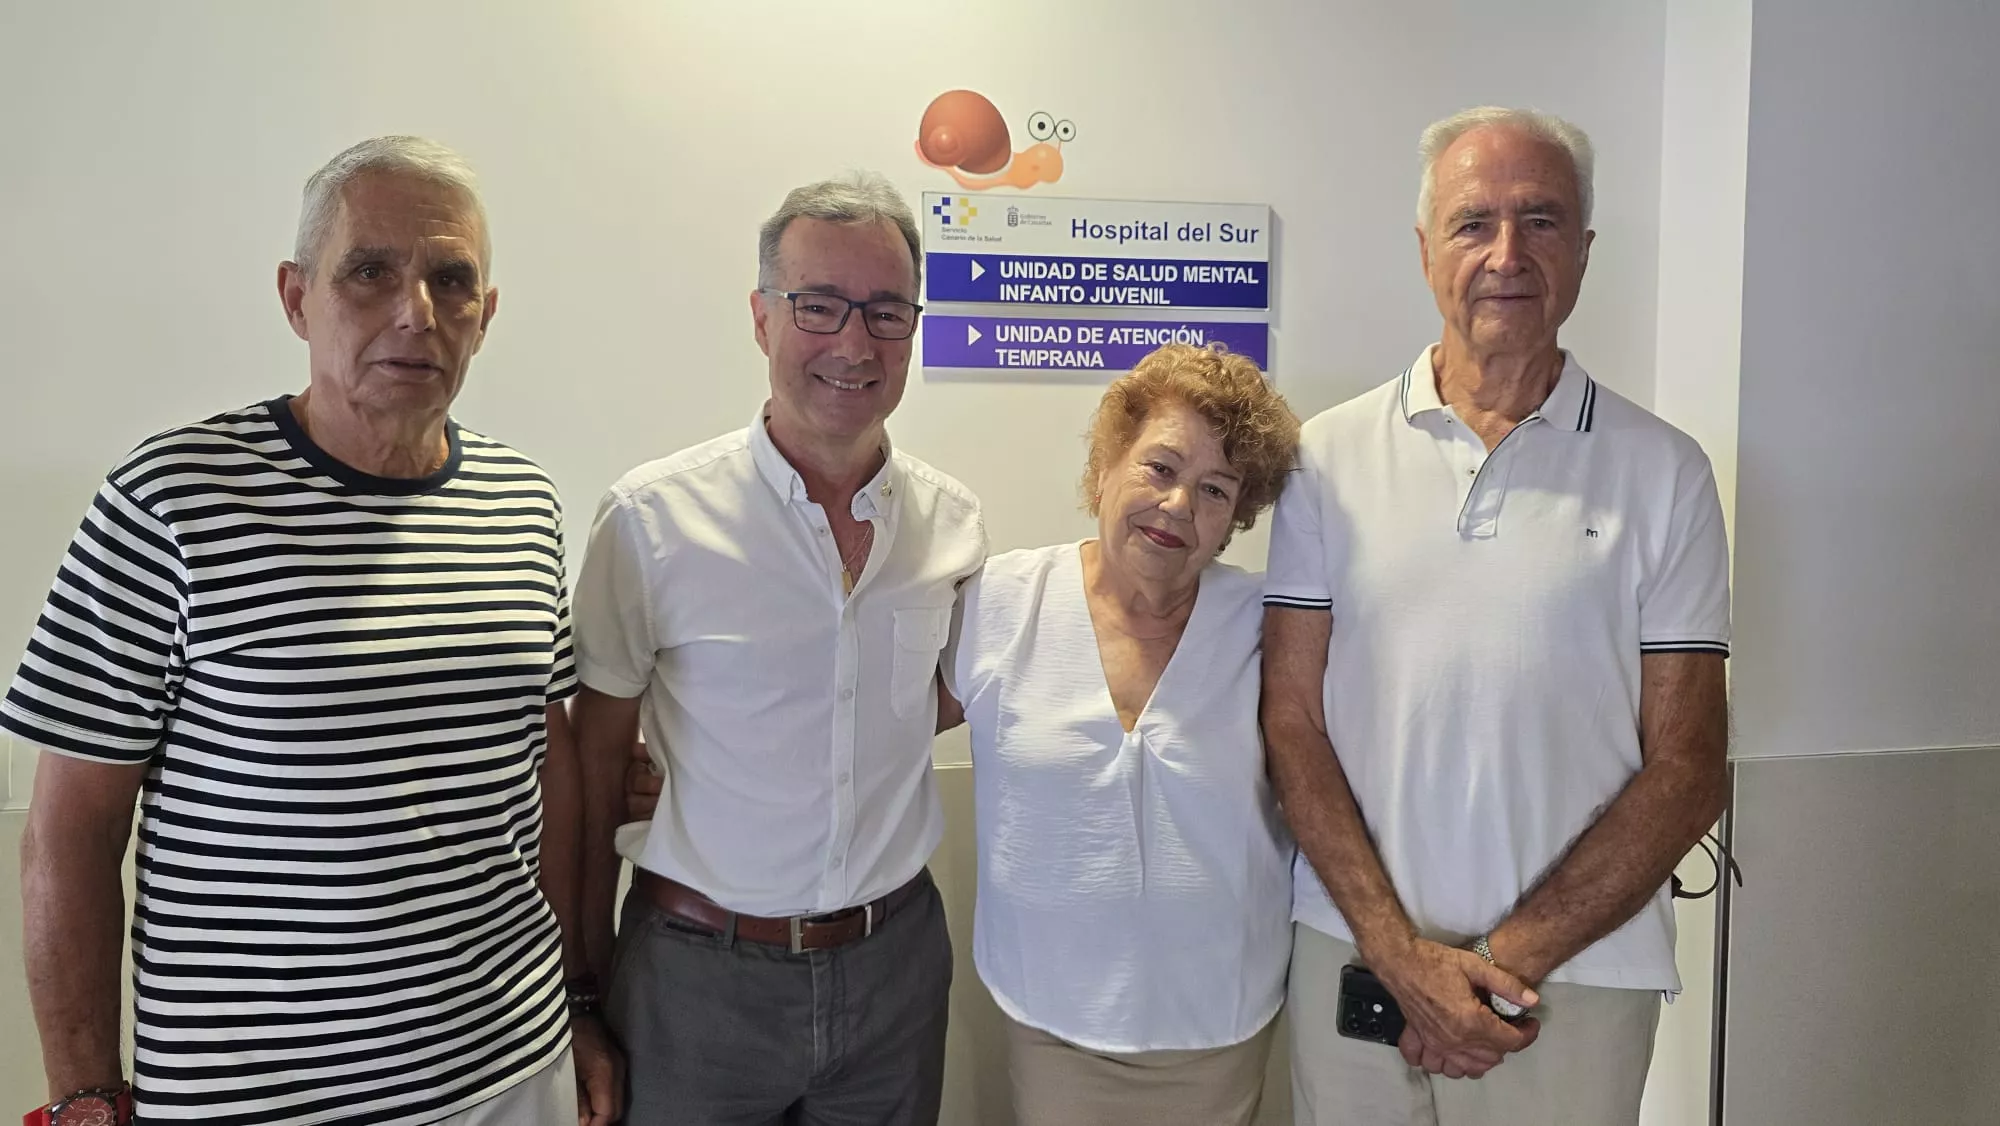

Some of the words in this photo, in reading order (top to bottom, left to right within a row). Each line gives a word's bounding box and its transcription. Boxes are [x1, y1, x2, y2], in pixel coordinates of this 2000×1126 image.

[1071, 218, 1169, 245] Hospital
[1177, 222, 1211, 242] del
[1219, 223, 1260, 243] Sur
[1000, 261, 1076, 280] UNIDAD
[1081, 263, 1108, 280] DE
[1112, 264, 1178, 283] SALUD
[1183, 266, 1259, 284] MENTAL
[1000, 284, 1085, 303] INFANTO
[1089, 286, 1170, 305] JUVENIL
[995, 325, 1072, 344] UNIDAD
[1077, 327, 1104, 344] DE
[1108, 324, 1204, 346] ATENCIÓN
[995, 349, 1104, 367] TEMPRANA
